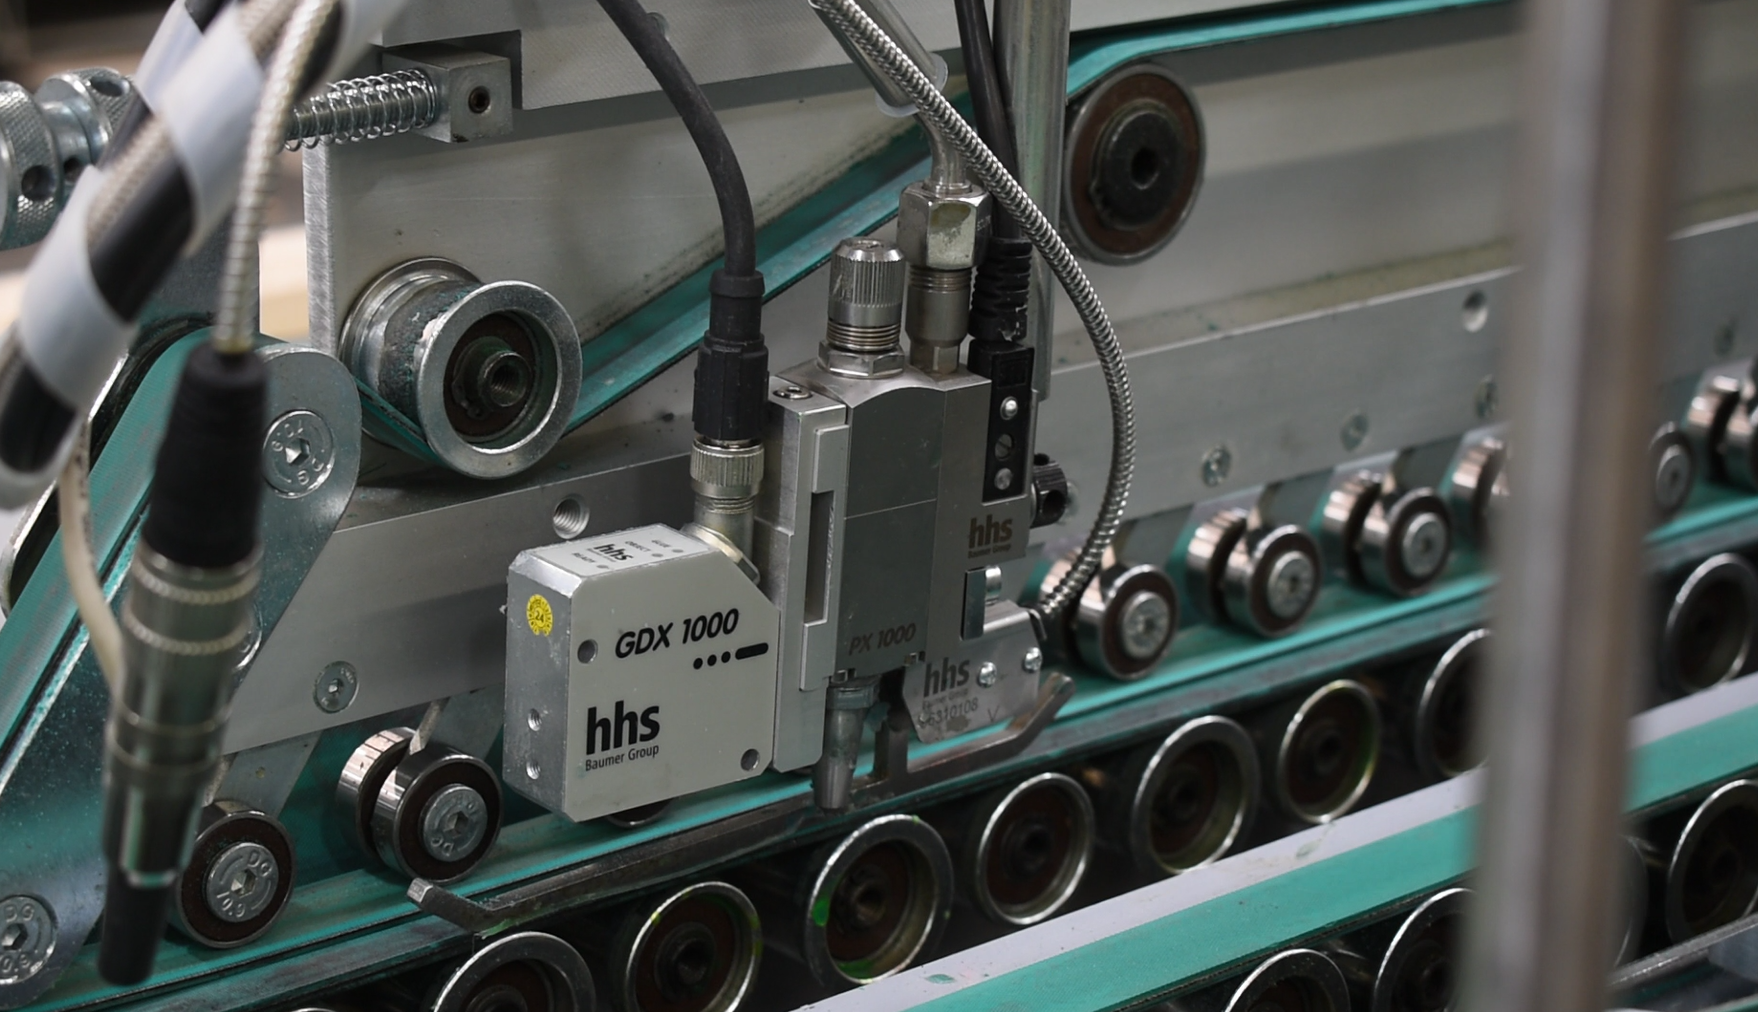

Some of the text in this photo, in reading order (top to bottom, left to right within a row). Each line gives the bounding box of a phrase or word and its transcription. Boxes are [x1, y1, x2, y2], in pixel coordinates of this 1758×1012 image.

[968, 513, 1013, 549] hhs
[593, 543, 634, 561] hhs
[614, 607, 740, 659] GDX 1000
[848, 622, 917, 656] PX 1000
[923, 656, 970, 698] hhs
[585, 700, 661, 755] hhs
[585, 745, 659, 771] Baumer Group
[216, 890, 246, 918] 10.9
